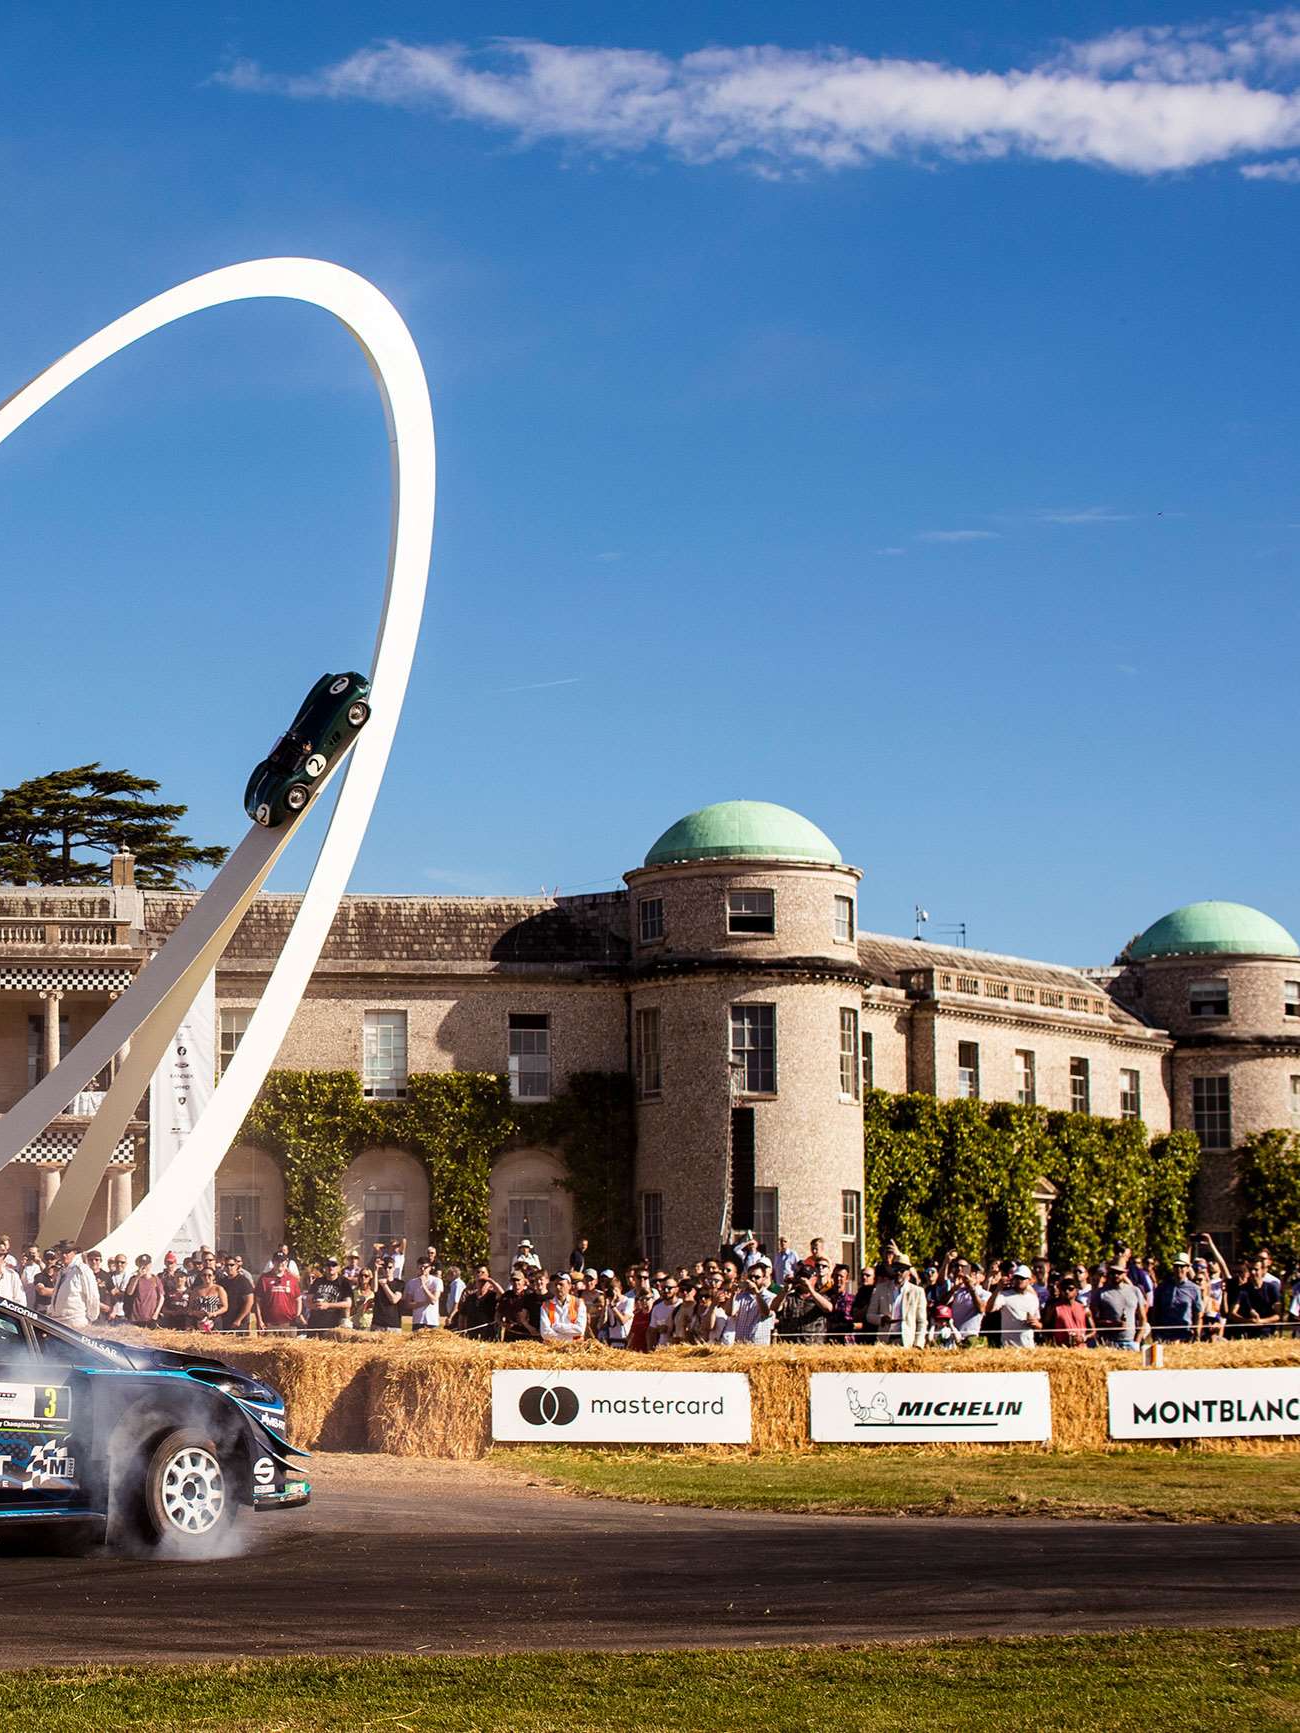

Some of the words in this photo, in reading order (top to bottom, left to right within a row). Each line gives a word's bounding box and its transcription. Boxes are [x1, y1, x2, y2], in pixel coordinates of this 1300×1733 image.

[308, 758, 324, 772] 2
[259, 807, 268, 823] 2
[0, 1299, 39, 1320] Acronis
[80, 1335, 119, 1358] PULSAR
[43, 1387, 58, 1418] 3
[591, 1396, 724, 1416] mastercard
[897, 1401, 1023, 1417] MICHELIN
[1133, 1398, 1300, 1425] MONTBLANC
